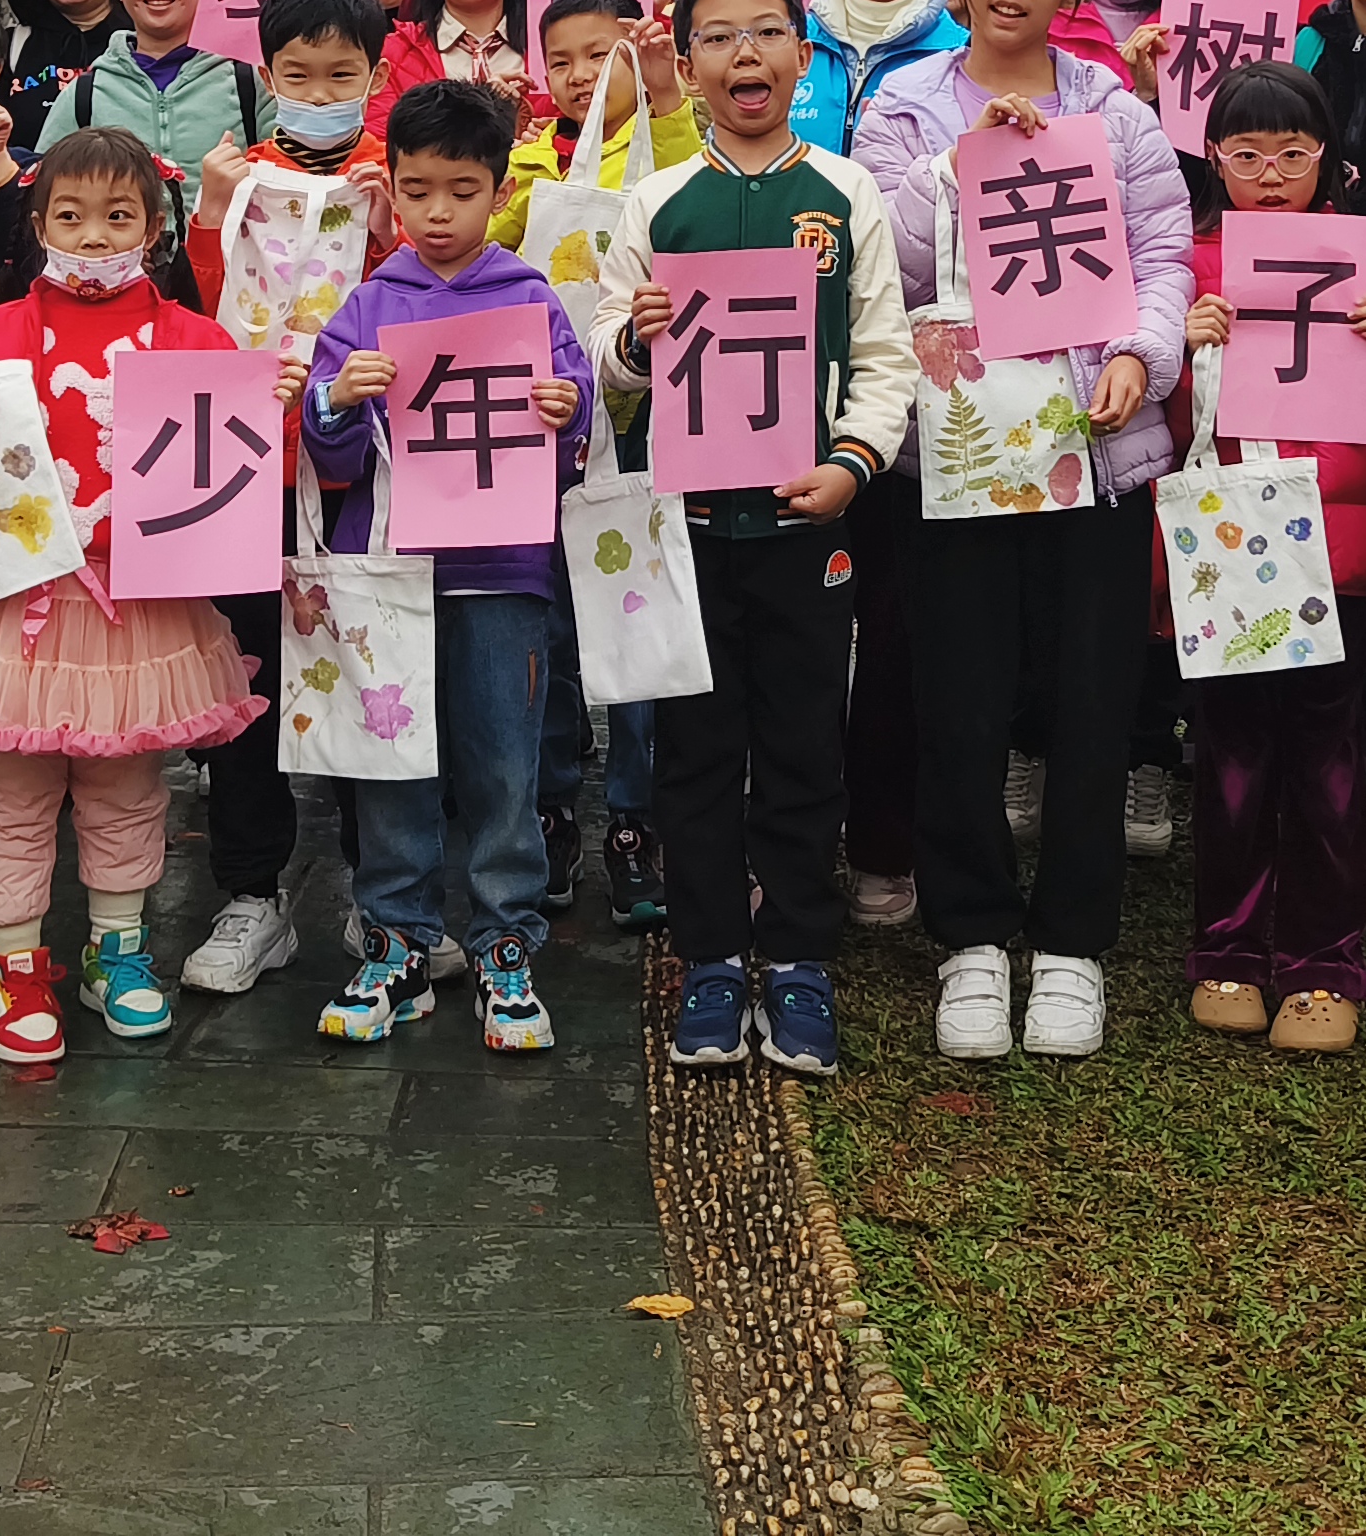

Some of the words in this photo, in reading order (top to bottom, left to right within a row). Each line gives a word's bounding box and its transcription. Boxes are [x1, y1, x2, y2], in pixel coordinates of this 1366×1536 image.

[1167, 3, 1285, 112] 树
[979, 158, 1113, 296] 亲
[667, 289, 806, 436] 行
[1235, 259, 1357, 384] 子
[131, 392, 272, 537] 少
[406, 354, 546, 490] 年
